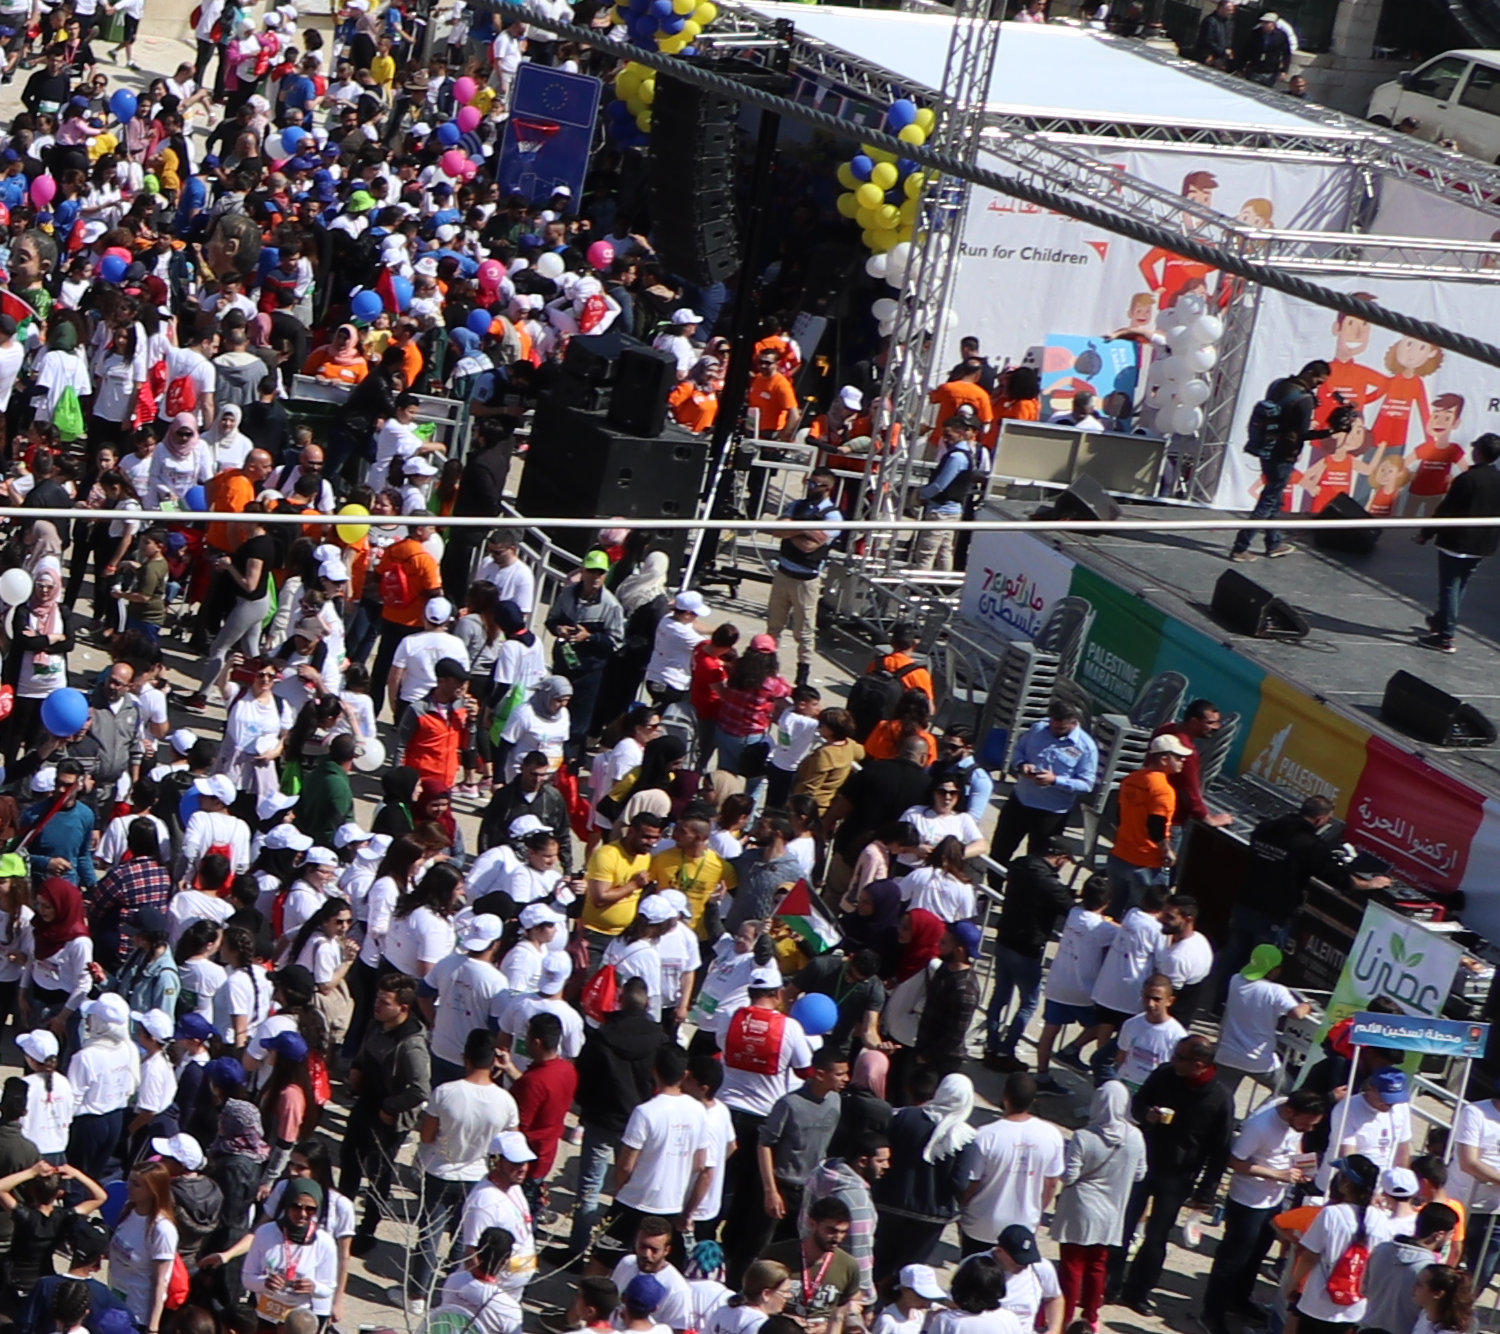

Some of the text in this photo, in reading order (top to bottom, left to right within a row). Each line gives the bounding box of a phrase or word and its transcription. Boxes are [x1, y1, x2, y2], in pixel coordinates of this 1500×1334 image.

[958, 241, 1089, 267] Run for Children
[1082, 658, 1137, 706] MARATHON
[1088, 641, 1142, 686] PALESTINE
[1280, 756, 1342, 802] PALESTINE
